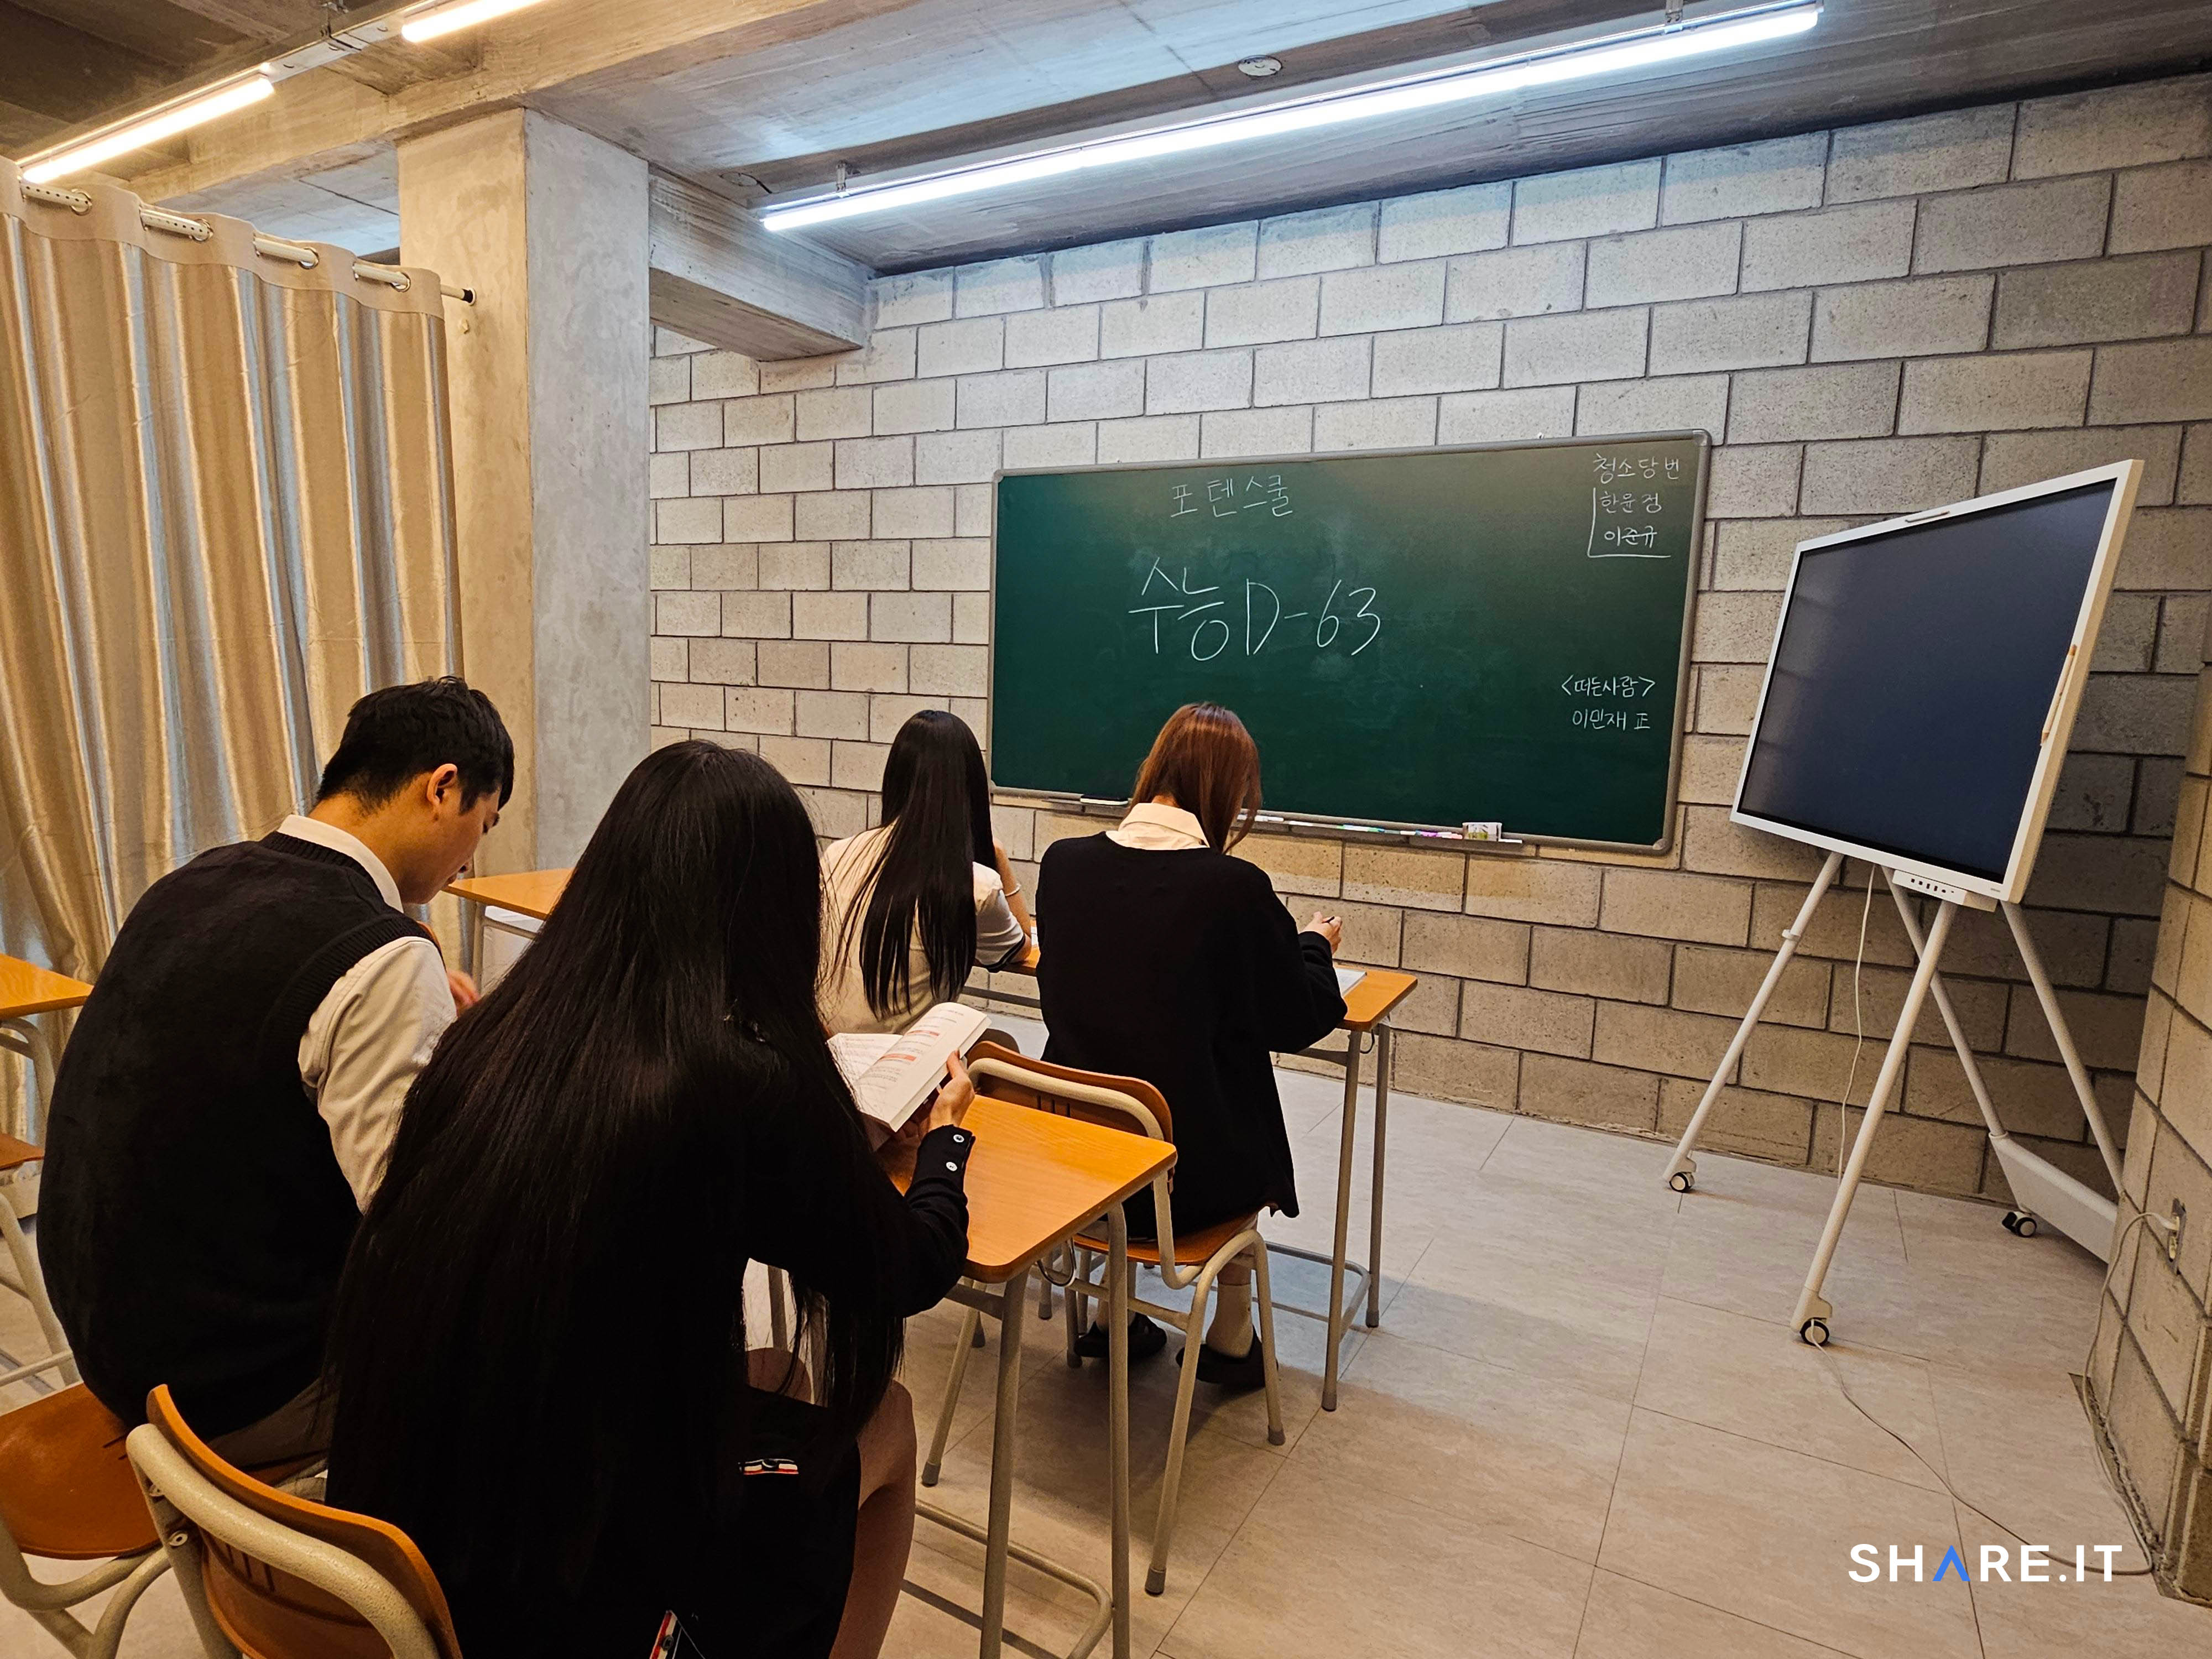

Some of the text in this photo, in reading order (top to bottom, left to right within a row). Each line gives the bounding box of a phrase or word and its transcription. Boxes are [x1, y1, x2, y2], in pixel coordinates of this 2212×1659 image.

[1593, 453, 1679, 484] 청소당번
[1171, 474, 1293, 518] 포텐스쿨
[1572, 708, 1626, 731] 이민재
